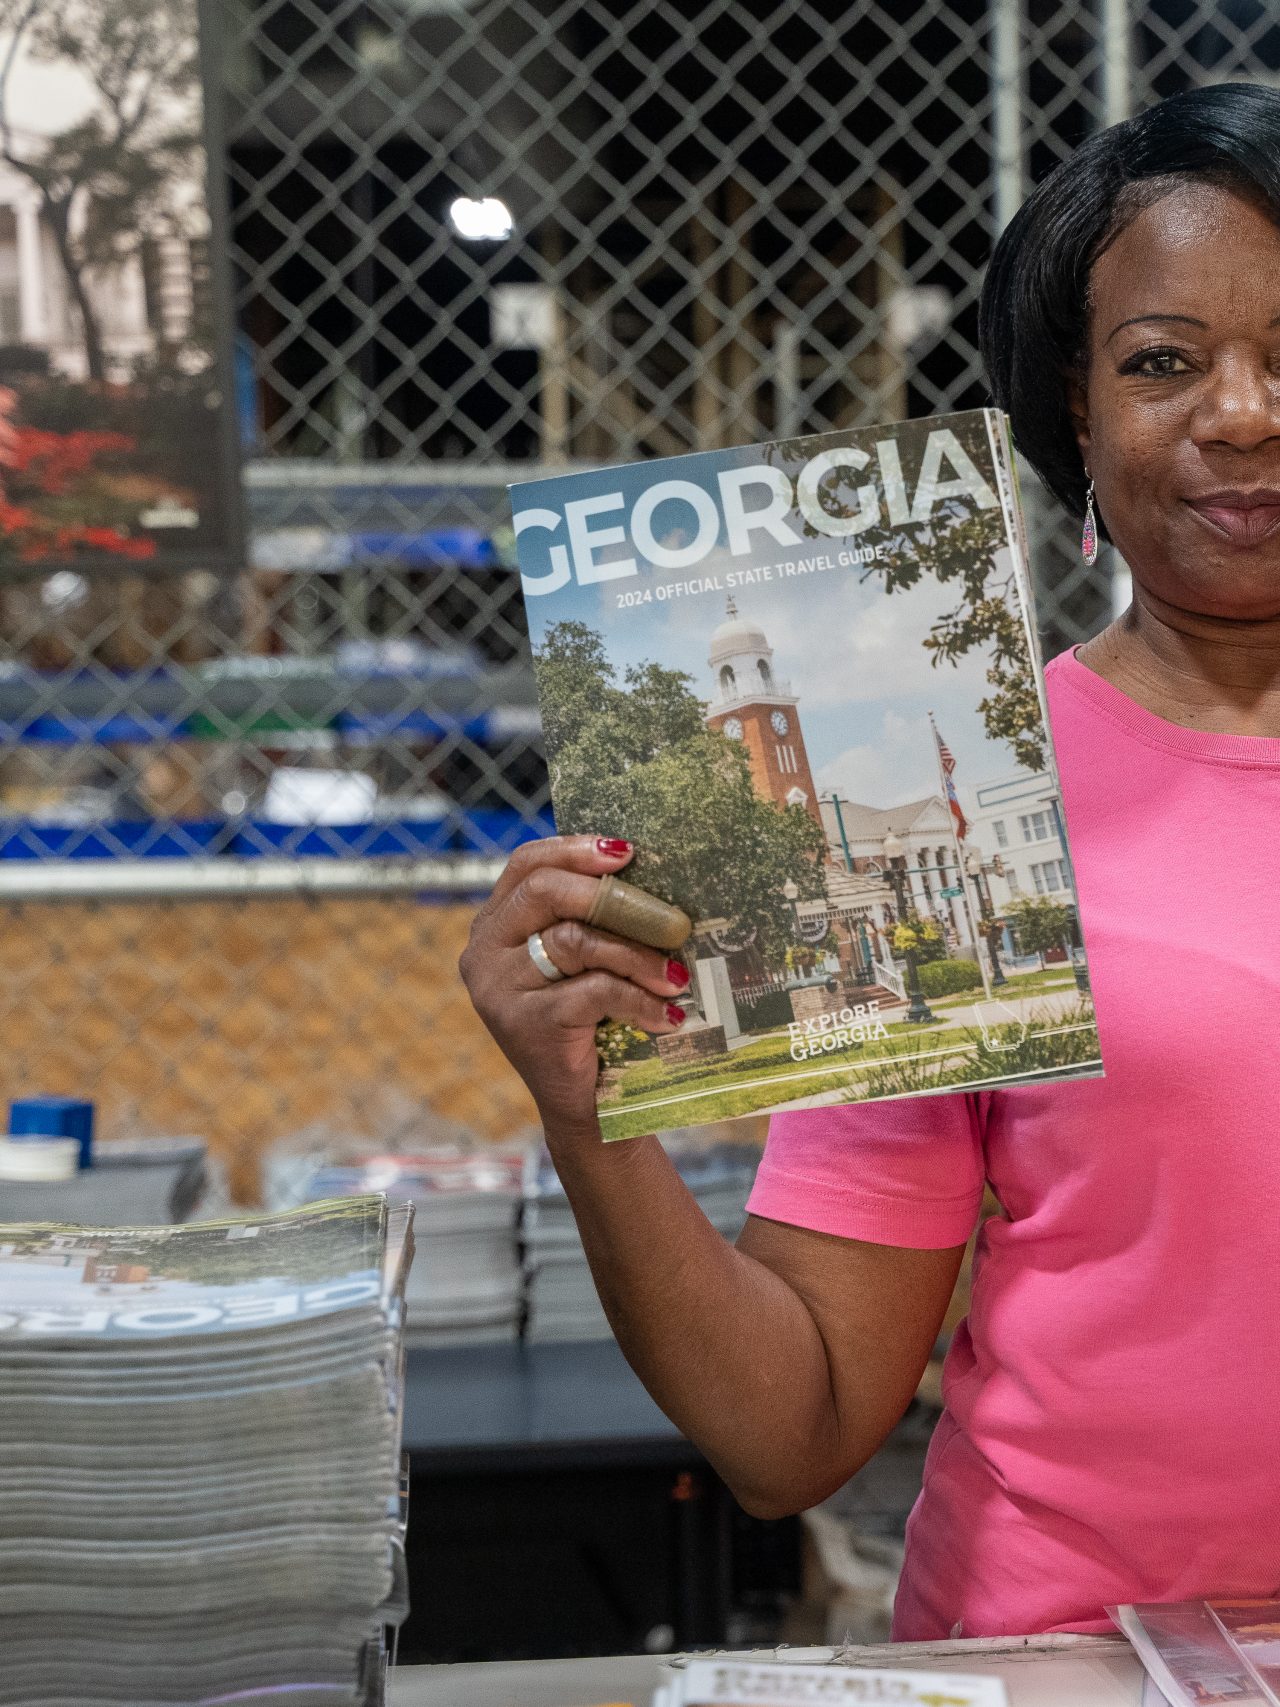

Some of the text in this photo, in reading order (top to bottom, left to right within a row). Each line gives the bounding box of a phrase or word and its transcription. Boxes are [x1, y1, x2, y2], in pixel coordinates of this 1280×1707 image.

[512, 428, 1000, 597] GEORGIA
[616, 545, 886, 609] 2024 OFFICIAL STATE TRAVEL GUIDE
[787, 1000, 881, 1042] EXPLORE
[789, 1021, 890, 1062] GEORGIA
[0, 1281, 380, 1331] GEOR
